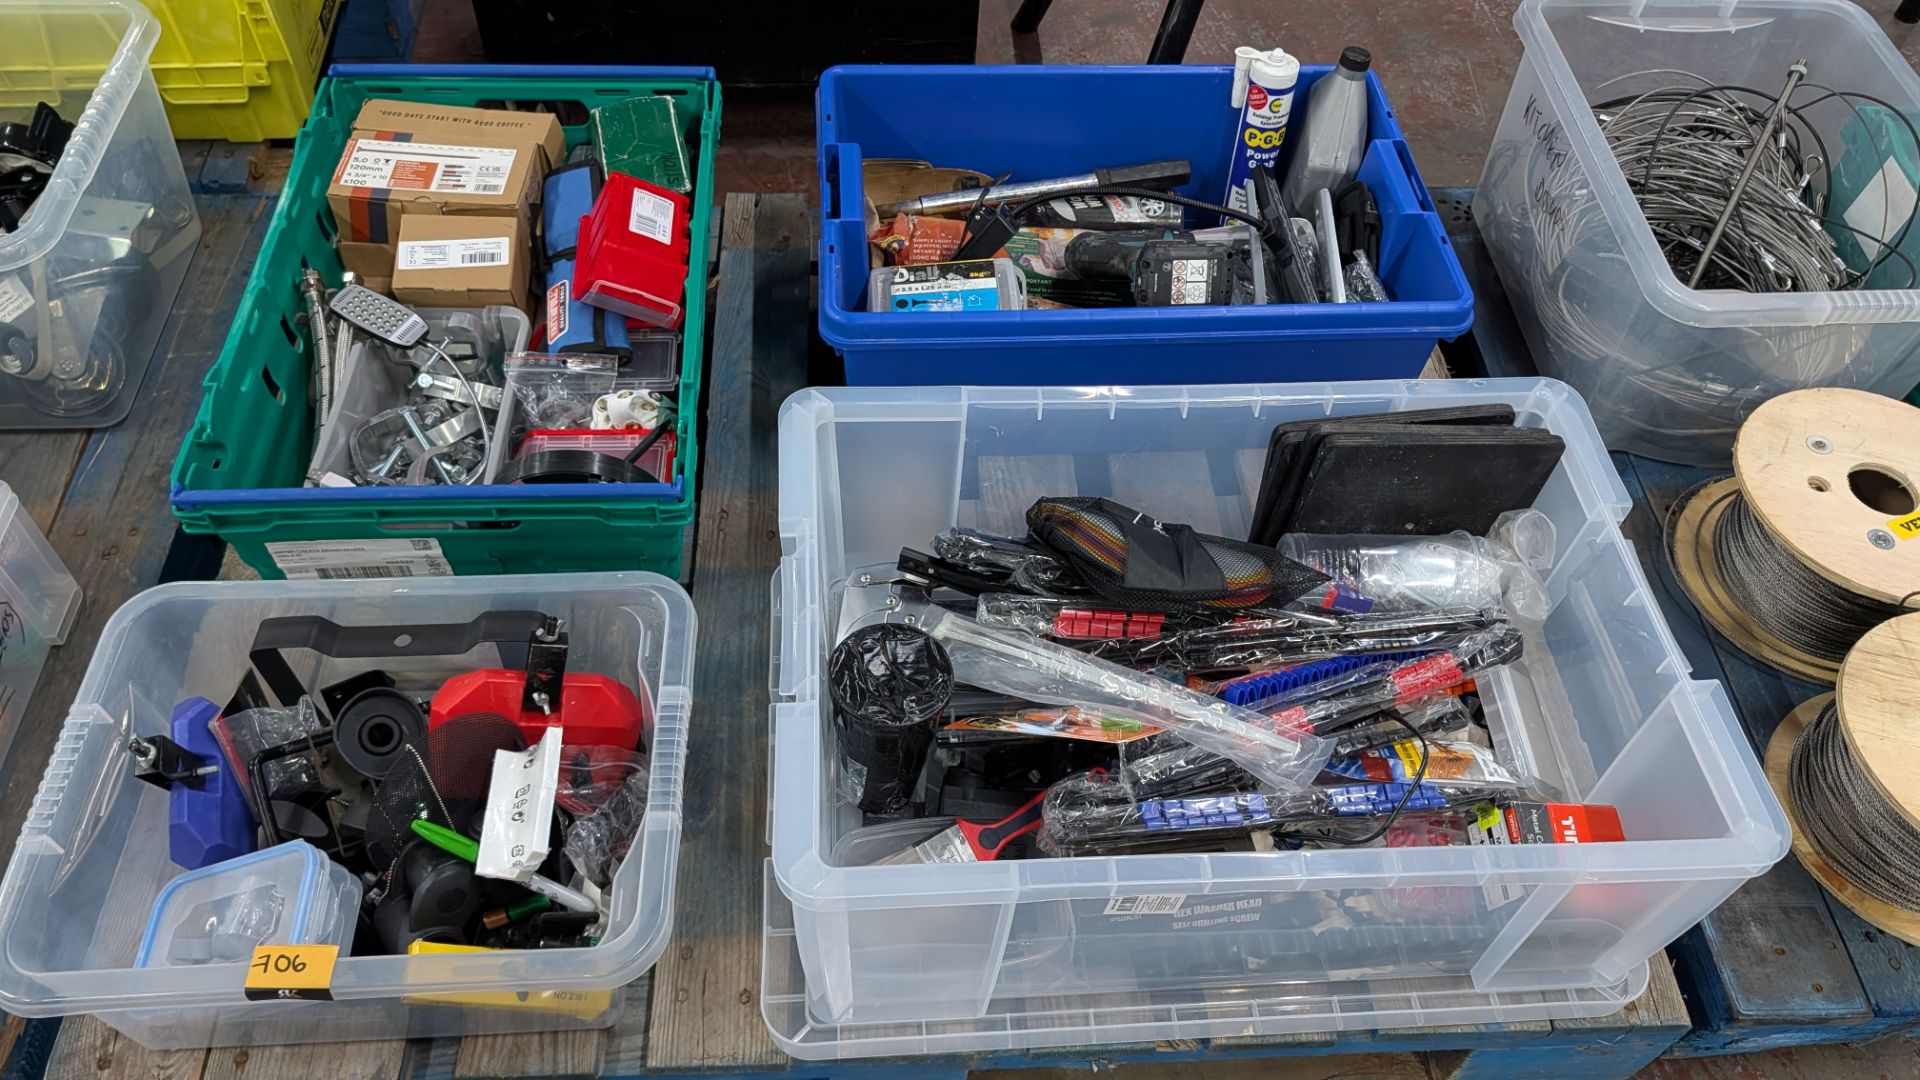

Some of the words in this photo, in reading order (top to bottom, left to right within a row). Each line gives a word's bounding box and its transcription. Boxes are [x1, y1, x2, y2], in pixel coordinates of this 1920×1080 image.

[427, 114, 450, 122] START
[1247, 148, 1280, 160] Power
[350, 164, 383, 172] 120mm
[1248, 160, 1275, 168] Gab
[1899, 517, 1920, 532] VE
[1531, 809, 1542, 833] Metal
[251, 954, 307, 974] 706
